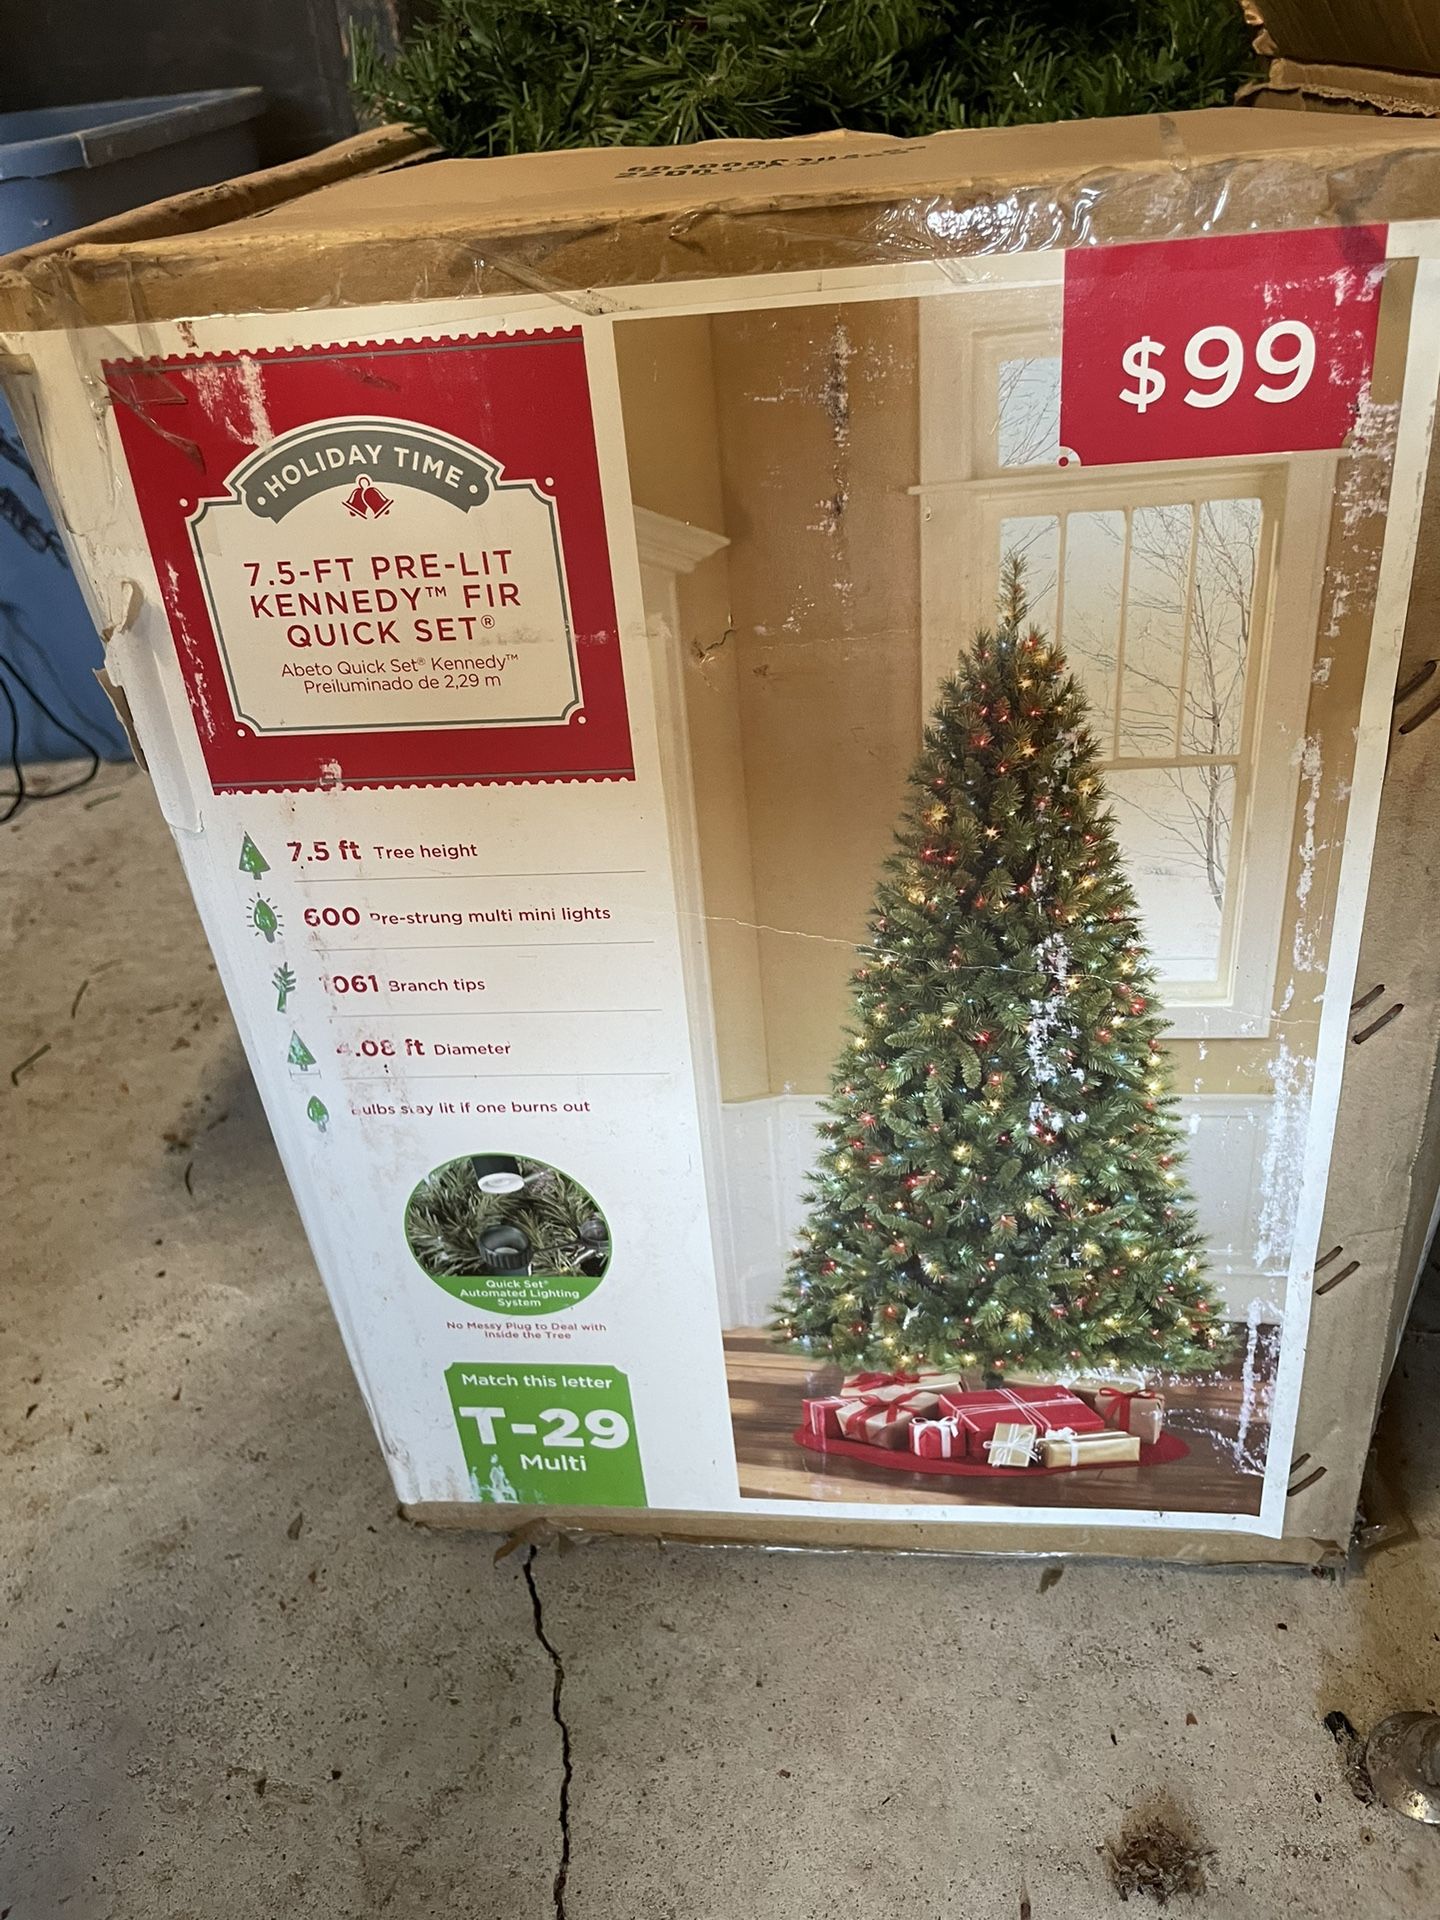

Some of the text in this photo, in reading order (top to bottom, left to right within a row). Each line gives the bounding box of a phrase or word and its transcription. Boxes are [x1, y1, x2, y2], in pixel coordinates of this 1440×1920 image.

[264, 444, 464, 498] HOLIDAY TIME
[243, 549, 512, 586] 7.5-FT PRE-LIT
[463, 583, 521, 608] FIR
[286, 620, 400, 648] QUICK
[281, 662, 332, 677] Abeto
[337, 656, 385, 675] Quick
[304, 673, 501, 694] Preiluminado de 2,29 m
[287, 840, 478, 862] 7.5 ft Tree height
[304, 907, 360, 927] 600
[469, 908, 513, 923] multi
[519, 907, 556, 921] mini
[561, 906, 611, 924] lights
[389, 978, 448, 992] Branch
[453, 978, 485, 993] tips
[336, 1038, 511, 1057] .08 ft Diameter
[439, 1102, 455, 1114] lit
[461, 1102, 471, 1114] if
[476, 1103, 506, 1114] one
[511, 1099, 558, 1114] burns
[563, 1100, 591, 1113] out
[486, 1279, 521, 1289] Quick
[460, 1289, 580, 1300] Automated Lighting
[498, 1298, 541, 1308] System
[447, 1321, 607, 1332] No Messy Plug to Deal with
[484, 1330, 572, 1340] Inside the Tree
[461, 1373, 613, 1390] Match this letter
[458, 1406, 631, 1450] T-29
[520, 1453, 588, 1472] Multi
